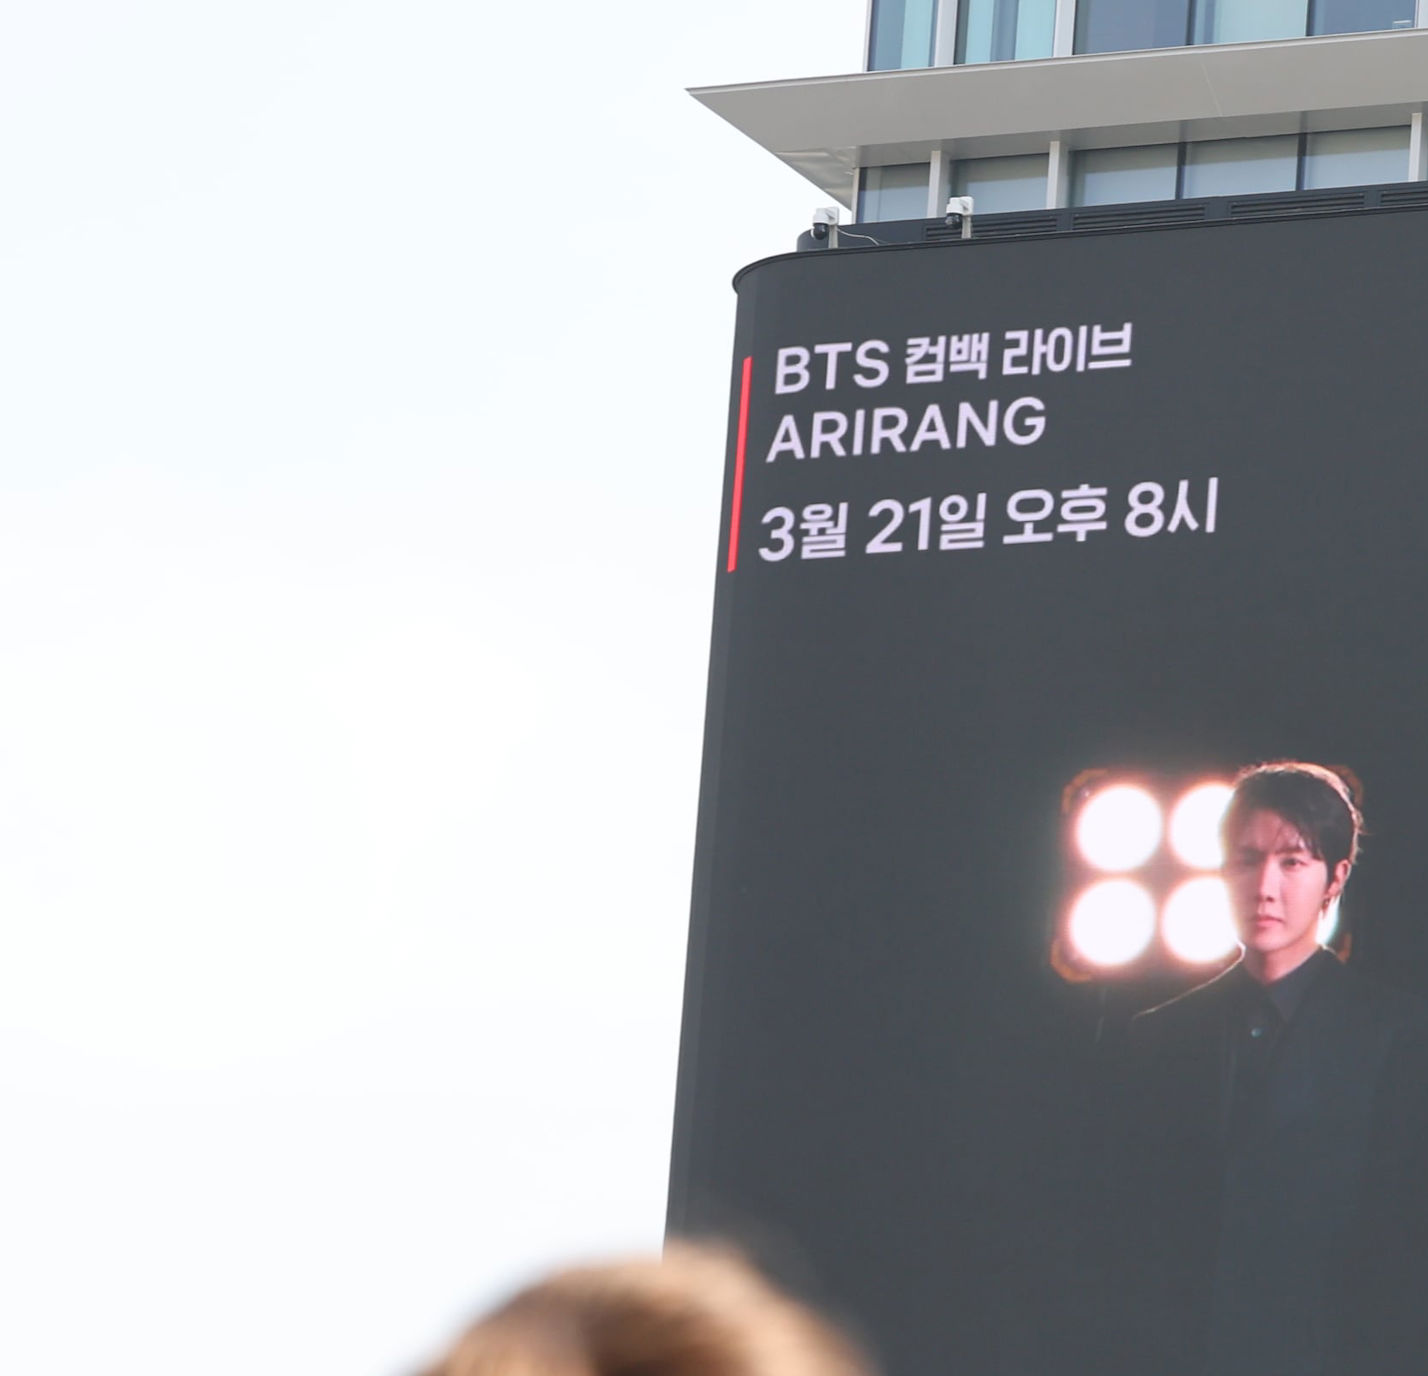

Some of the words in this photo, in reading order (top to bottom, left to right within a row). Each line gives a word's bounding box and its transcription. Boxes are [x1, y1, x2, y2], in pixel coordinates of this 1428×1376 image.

[775, 339, 890, 394] BTS
[904, 331, 990, 384] 컴백
[1001, 322, 1133, 376] 라이브
[766, 396, 1046, 463] ARIRANG
[758, 501, 849, 562] 3월
[865, 492, 987, 554] 21일
[1002, 483, 1108, 545] 오후
[1124, 476, 1219, 538] 8시
